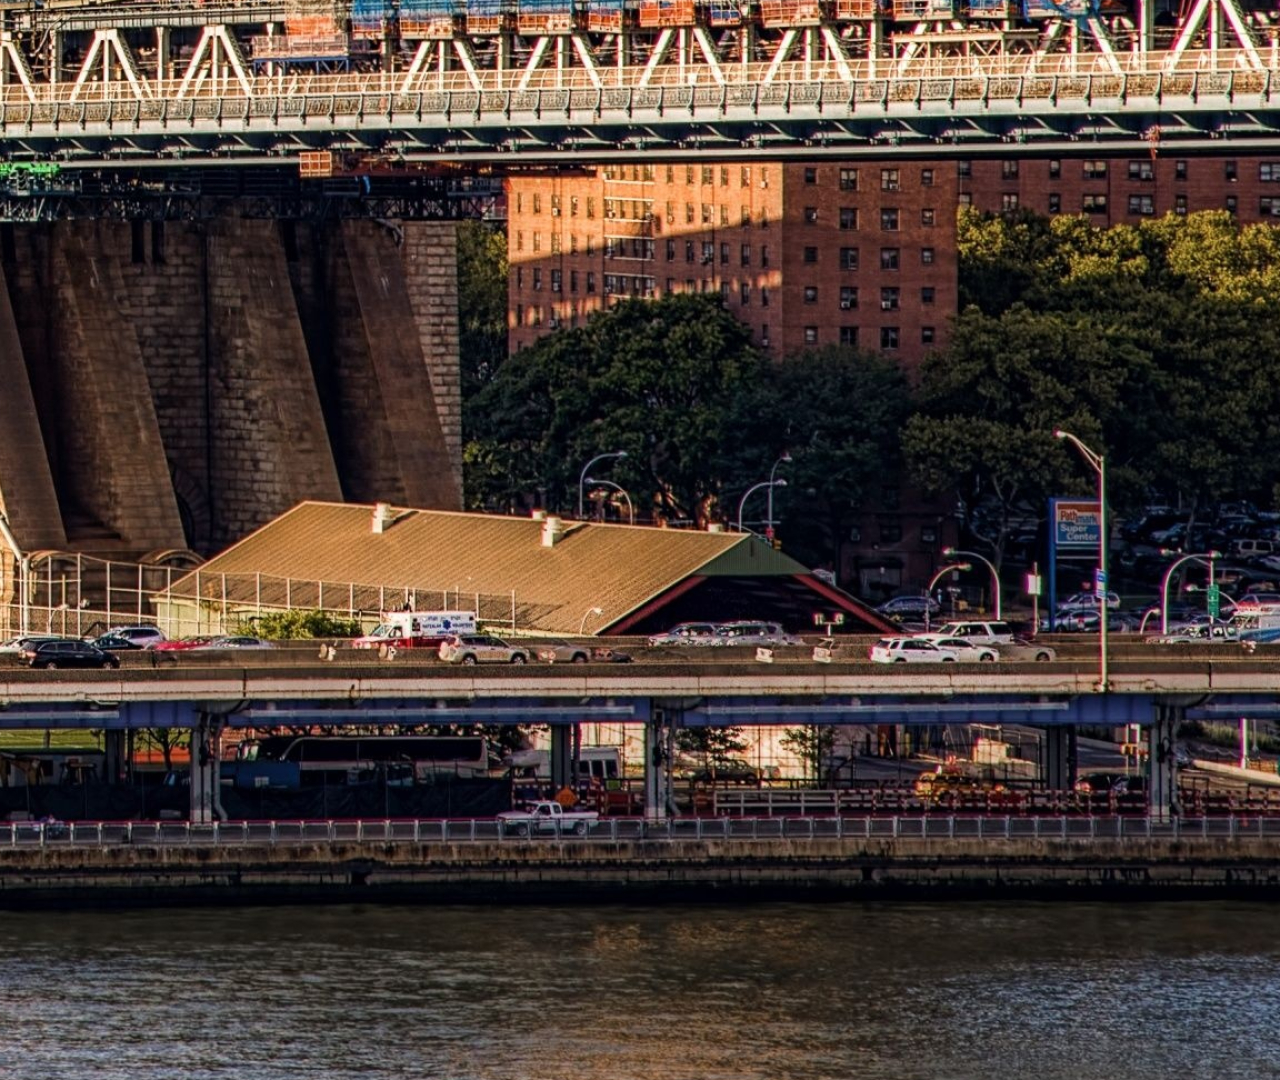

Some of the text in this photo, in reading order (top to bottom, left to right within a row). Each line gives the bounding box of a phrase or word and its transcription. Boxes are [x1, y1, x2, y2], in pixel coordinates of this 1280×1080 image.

[1059, 509, 1100, 524] Pathmark
[1060, 523, 1088, 533] Super
[1066, 532, 1099, 541] Center
